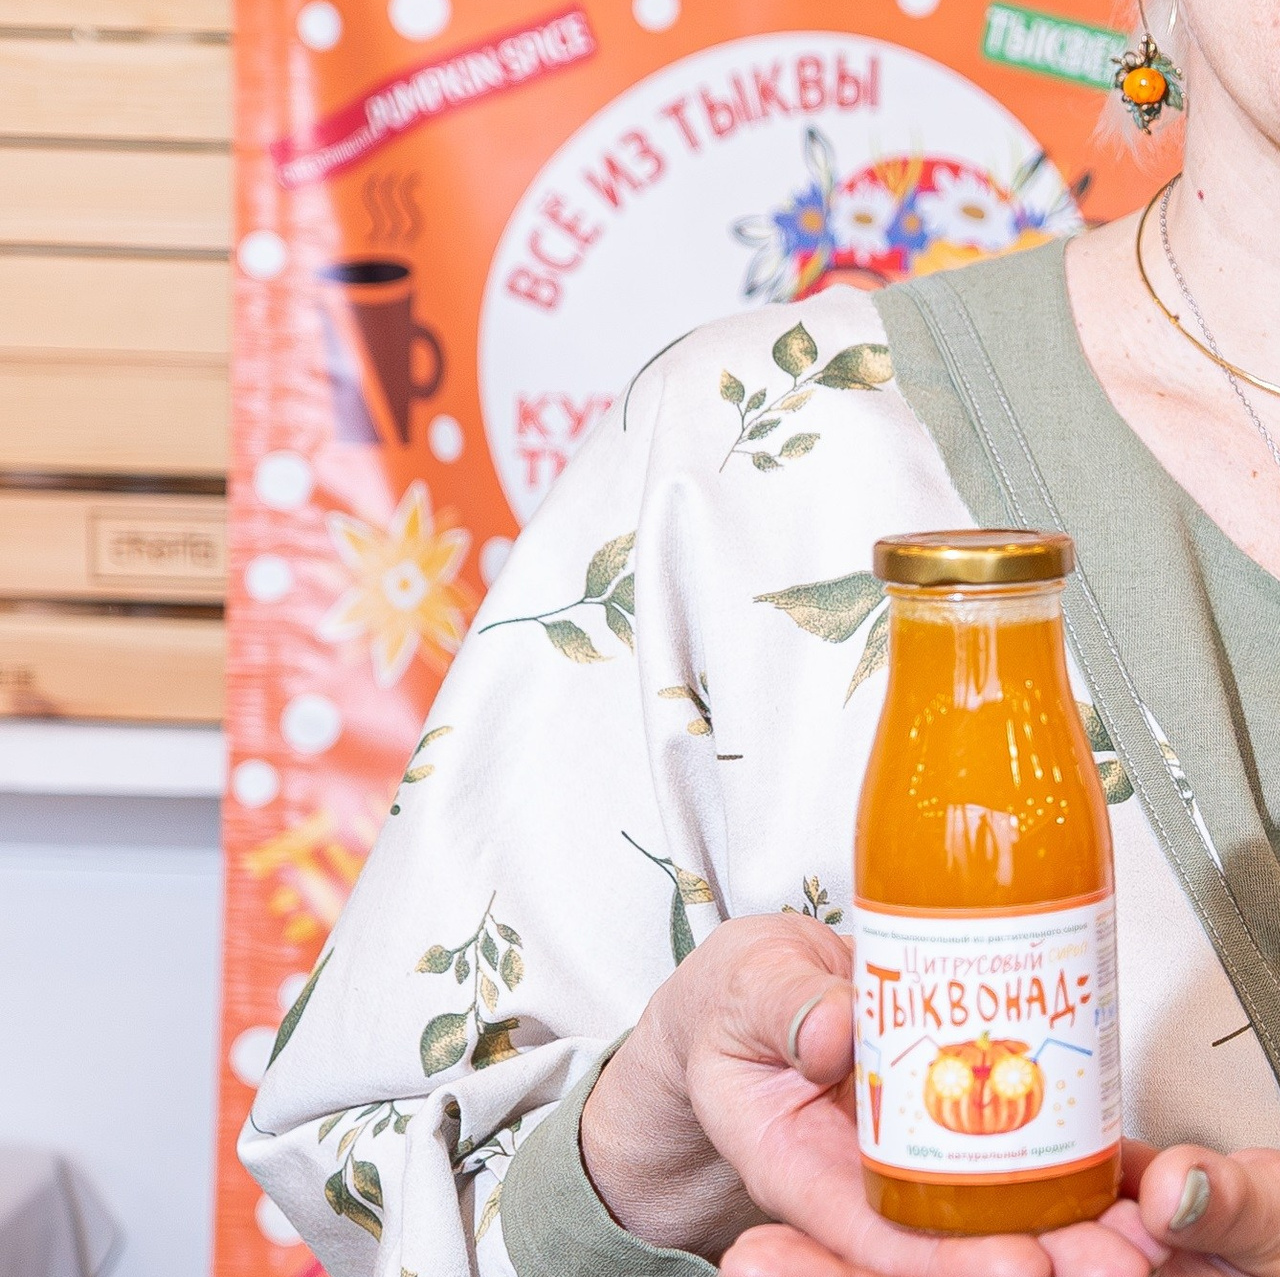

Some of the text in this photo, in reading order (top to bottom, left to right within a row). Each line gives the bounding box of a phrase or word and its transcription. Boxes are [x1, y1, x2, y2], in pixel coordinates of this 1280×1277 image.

[365, 11, 595, 137] PUMPKIN SPICE
[583, 129, 667, 211] ИЗ
[660, 53, 880, 151] ТЫКВЫ
[515, 392, 613, 439] КУ
[907, 1139, 1077, 1163] 100% натуральный продукт
